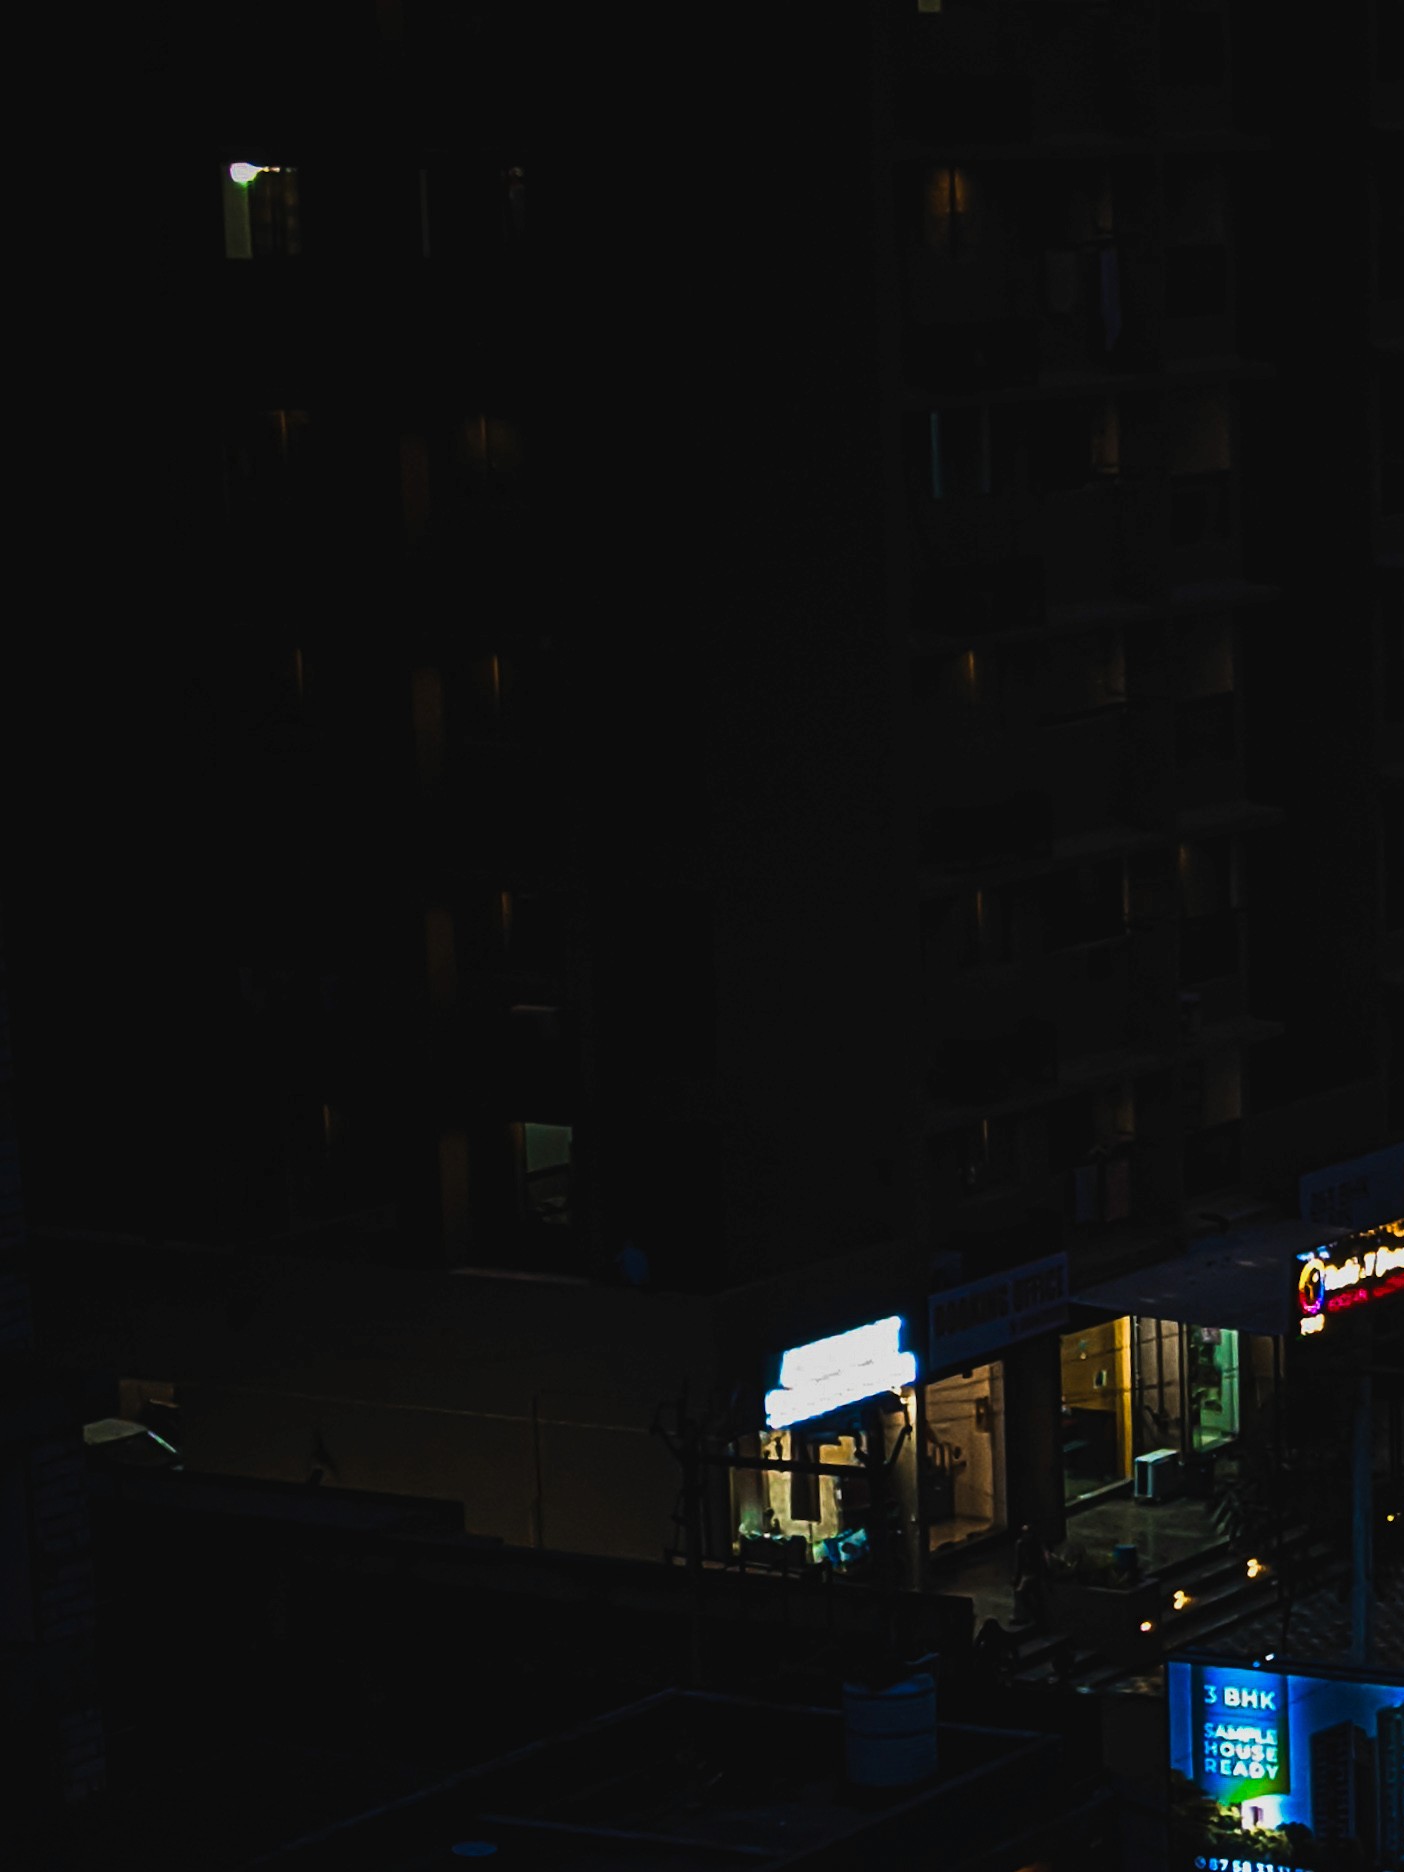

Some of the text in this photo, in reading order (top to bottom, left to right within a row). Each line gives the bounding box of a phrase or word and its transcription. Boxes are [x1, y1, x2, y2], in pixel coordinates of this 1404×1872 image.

[1202, 1684, 1277, 1711] 3 BHK
[1202, 1722, 1278, 1746] SAMPLE
[1202, 1740, 1279, 1763] HOUSE
[1202, 1757, 1280, 1781] READY
